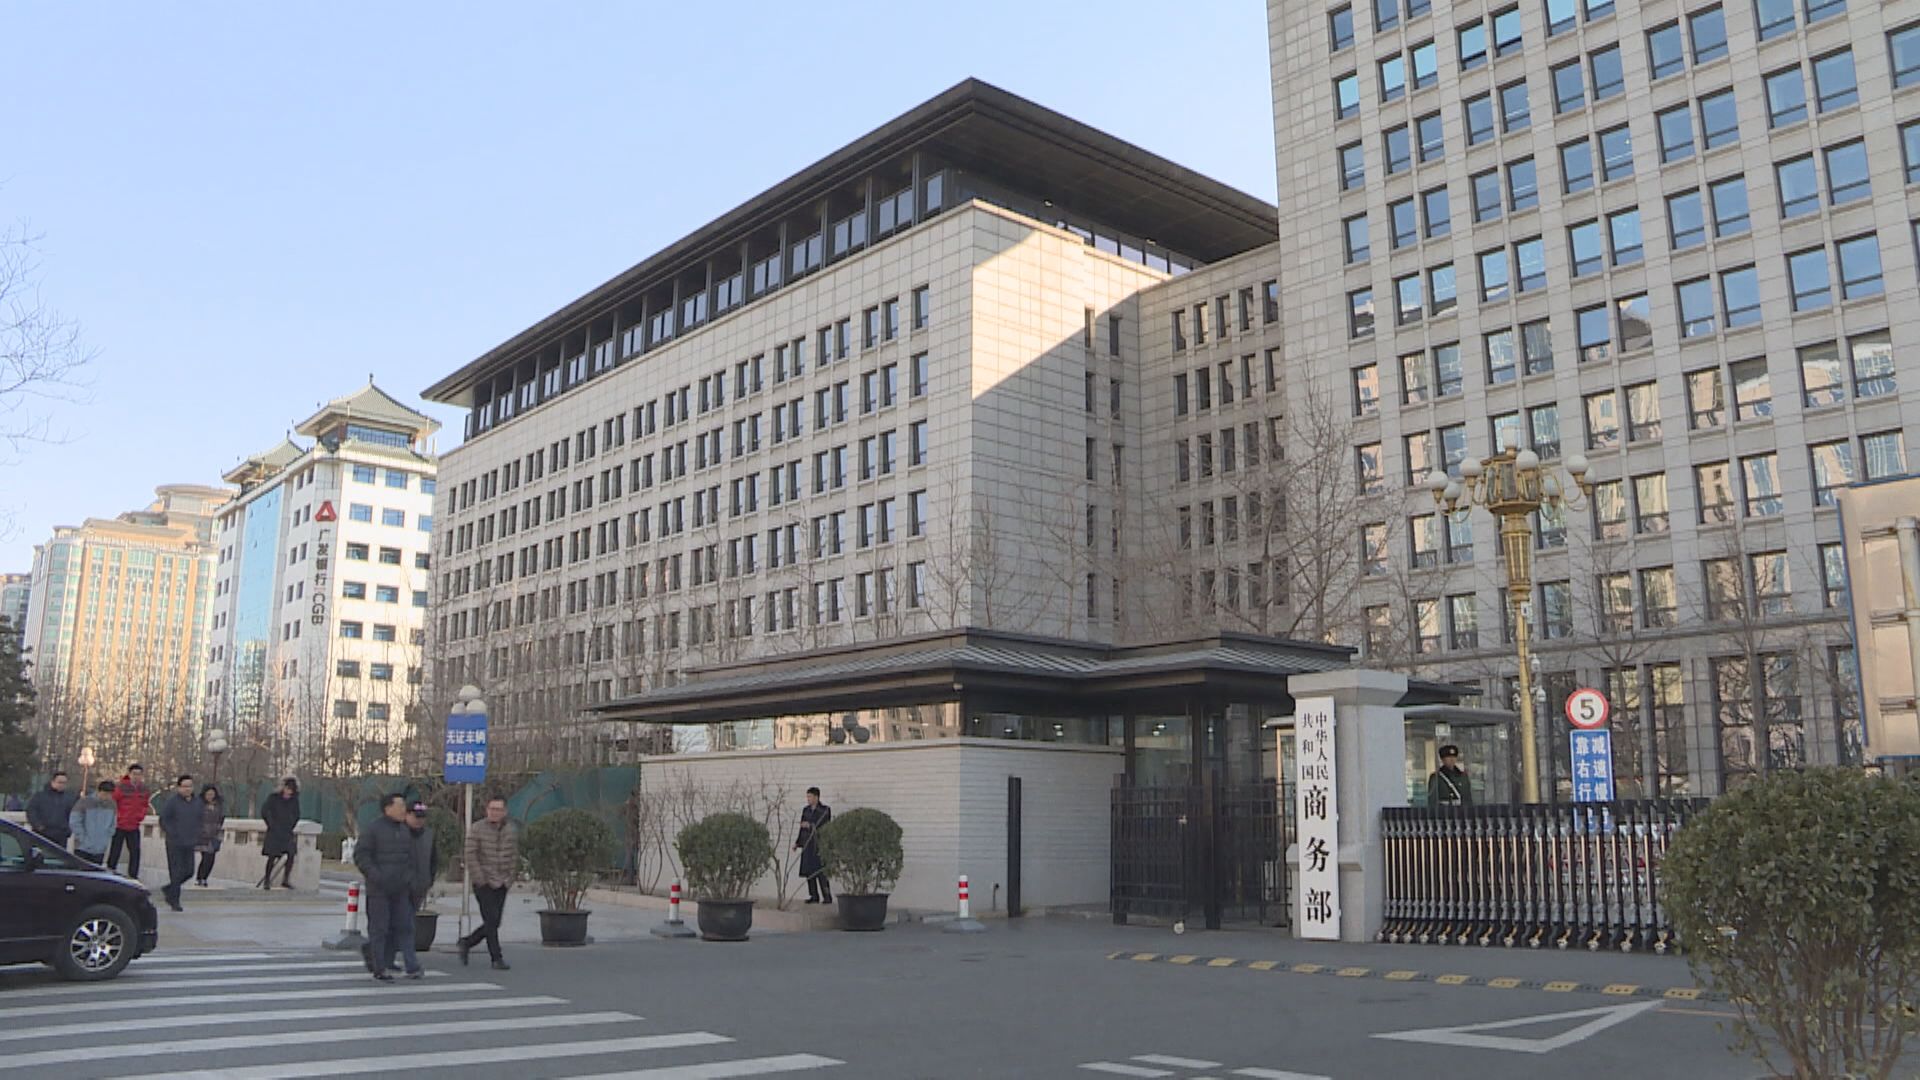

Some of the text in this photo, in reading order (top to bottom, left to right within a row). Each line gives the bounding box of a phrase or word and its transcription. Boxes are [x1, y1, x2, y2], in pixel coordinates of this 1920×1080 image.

[315, 529, 330, 585] 广发银行
[312, 594, 325, 624] CGB
[446, 729, 486, 744] 无证车辆
[1580, 699, 1595, 720] 5
[446, 752, 484, 766] 靠右检查
[1302, 712, 1314, 780] 共和国
[1316, 711, 1328, 780] 中华人民
[1576, 736, 1593, 824] 靠右行
[1303, 785, 1331, 923] 商务部
